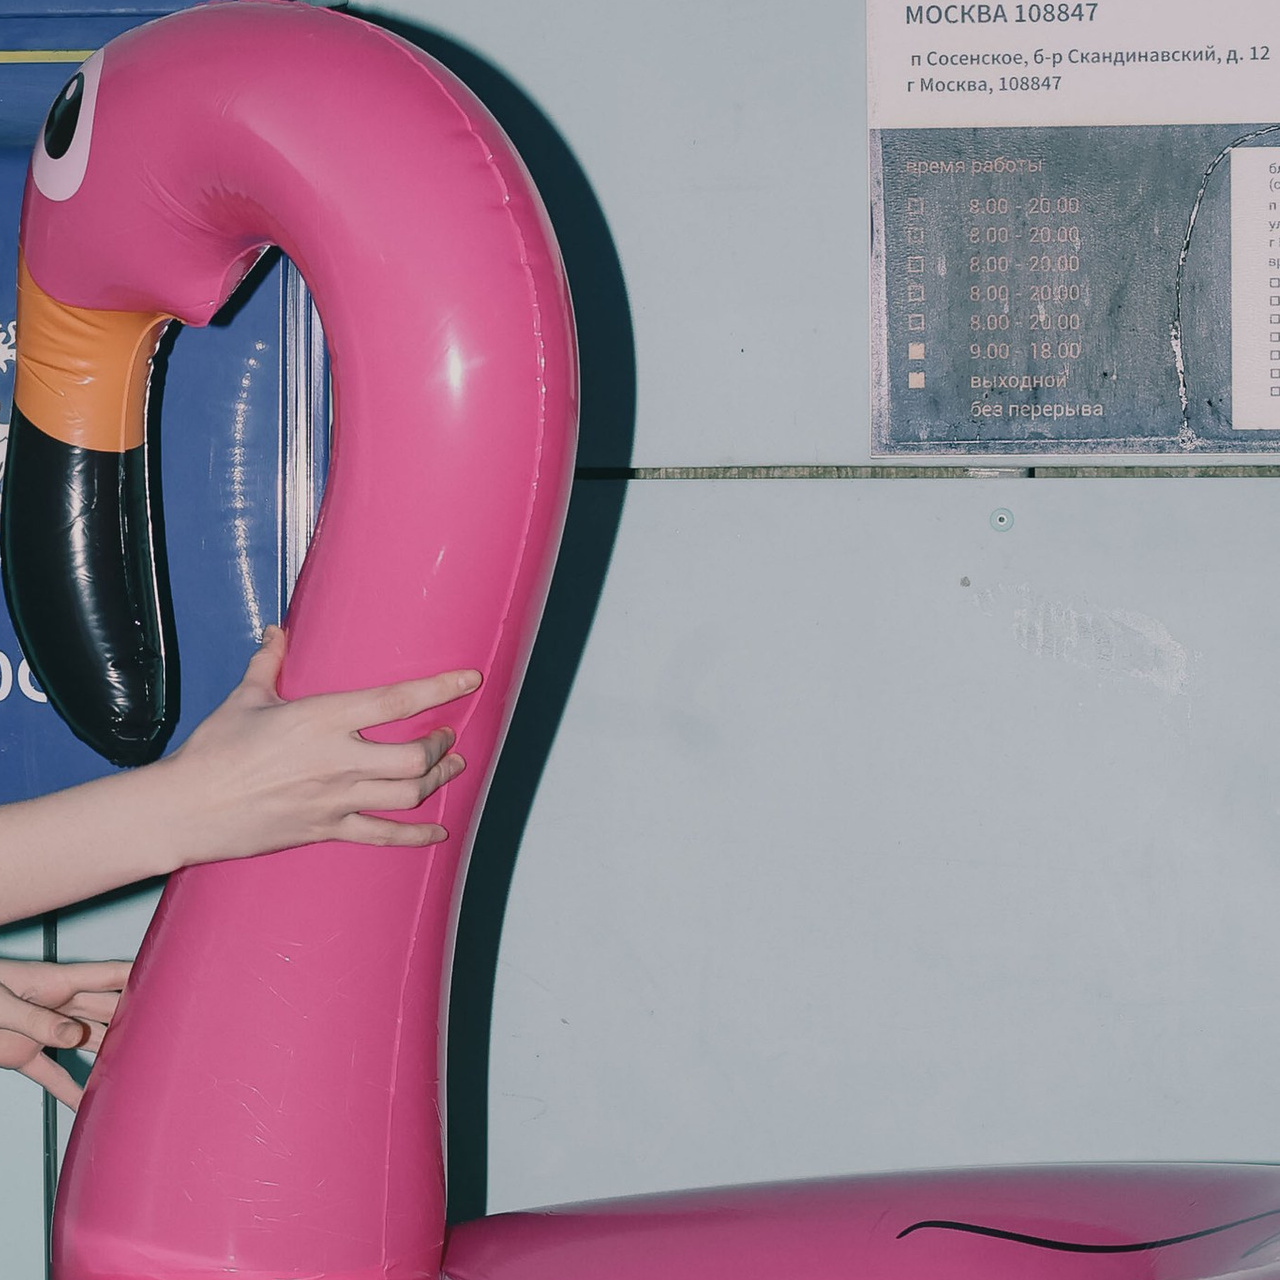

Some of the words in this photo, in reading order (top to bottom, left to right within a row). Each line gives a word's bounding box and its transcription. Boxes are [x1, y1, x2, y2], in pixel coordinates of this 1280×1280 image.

[906, 4, 1008, 24] МОСКВА
[1015, 2, 1098, 23] 108847
[911, 54, 921, 66] п
[927, 51, 1029, 67] Сосенское,
[1033, 49, 1063, 68] б-р
[1068, 45, 1221, 67] Скандинавский,
[1226, 49, 1244, 64] д.
[1250, 46, 1270, 61] 12
[907, 80, 915, 92] г
[920, 78, 994, 94] Москва,
[999, 76, 1062, 92] 108847
[906, 160, 965, 176] время
[971, 156, 1042, 175] работы
[970, 370, 1067, 391] выходной
[971, 401, 1003, 417] без
[1009, 403, 1104, 420] перерыва
